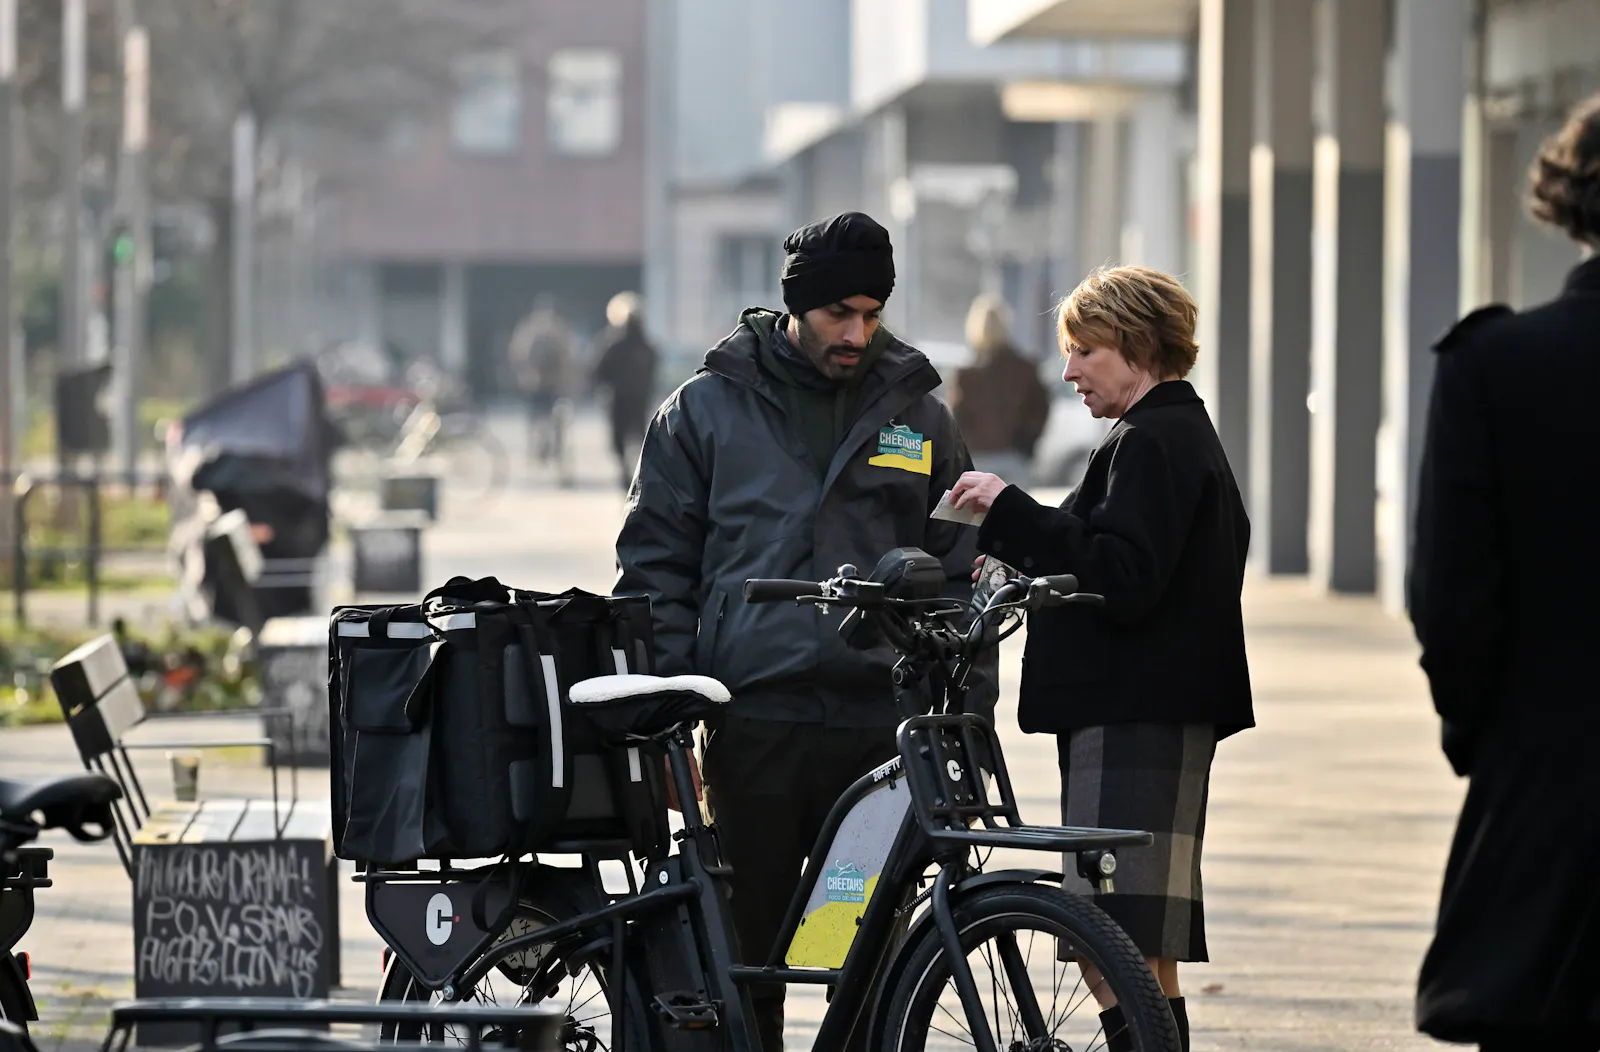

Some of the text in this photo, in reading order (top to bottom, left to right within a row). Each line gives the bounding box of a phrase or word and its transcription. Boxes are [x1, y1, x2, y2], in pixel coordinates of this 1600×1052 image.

[879, 432, 922, 450] CHEETAHS
[872, 759, 901, 782] 20FIFTY
[827, 876, 864, 892] CHEETAHS
